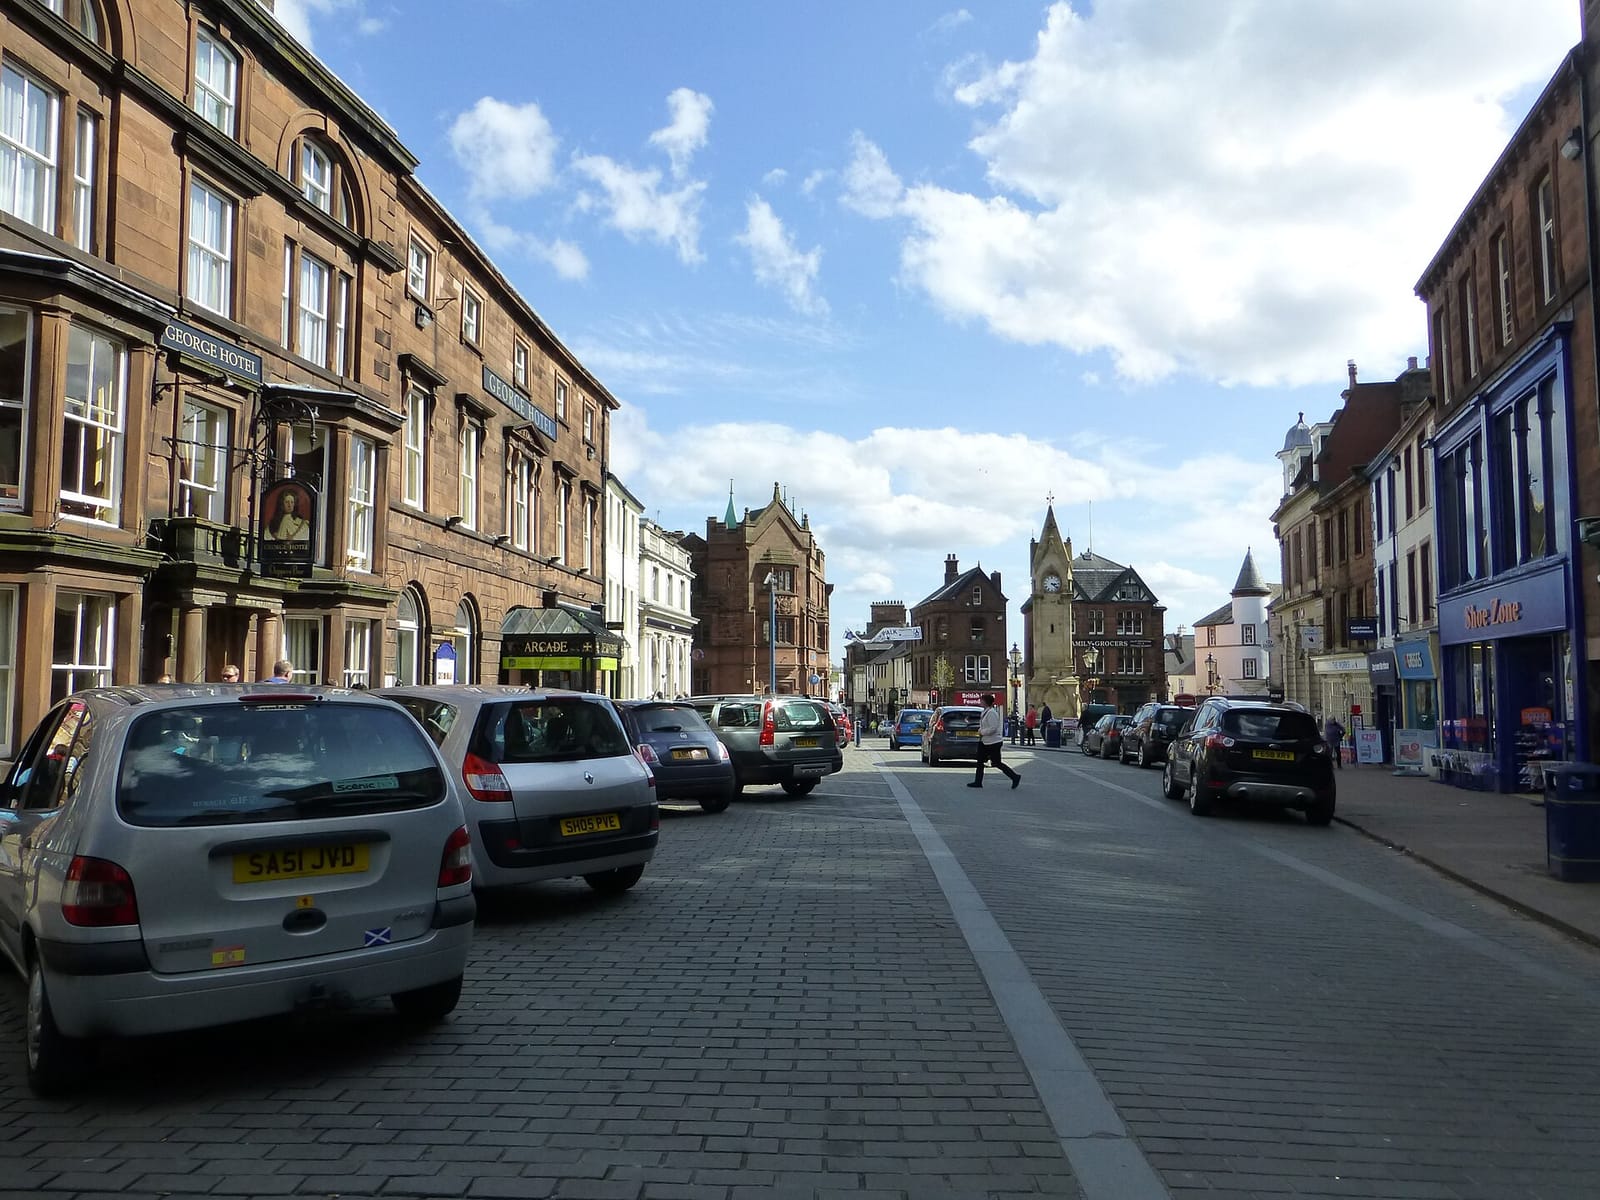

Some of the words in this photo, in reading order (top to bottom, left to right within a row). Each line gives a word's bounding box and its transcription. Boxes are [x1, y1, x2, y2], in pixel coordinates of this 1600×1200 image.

[165, 325, 218, 358] GEORGE
[219, 346, 258, 375] HOTEL
[489, 374, 526, 416] GEORGE
[528, 404, 553, 436] HOTEL
[1464, 604, 1489, 629] Shoe
[1490, 597, 1519, 625] Zone
[524, 641, 569, 653] ARCADE
[566, 817, 594, 833] SH05
[595, 815, 616, 829] PVE
[248, 849, 303, 876] SA51
[311, 846, 355, 870] JVD
